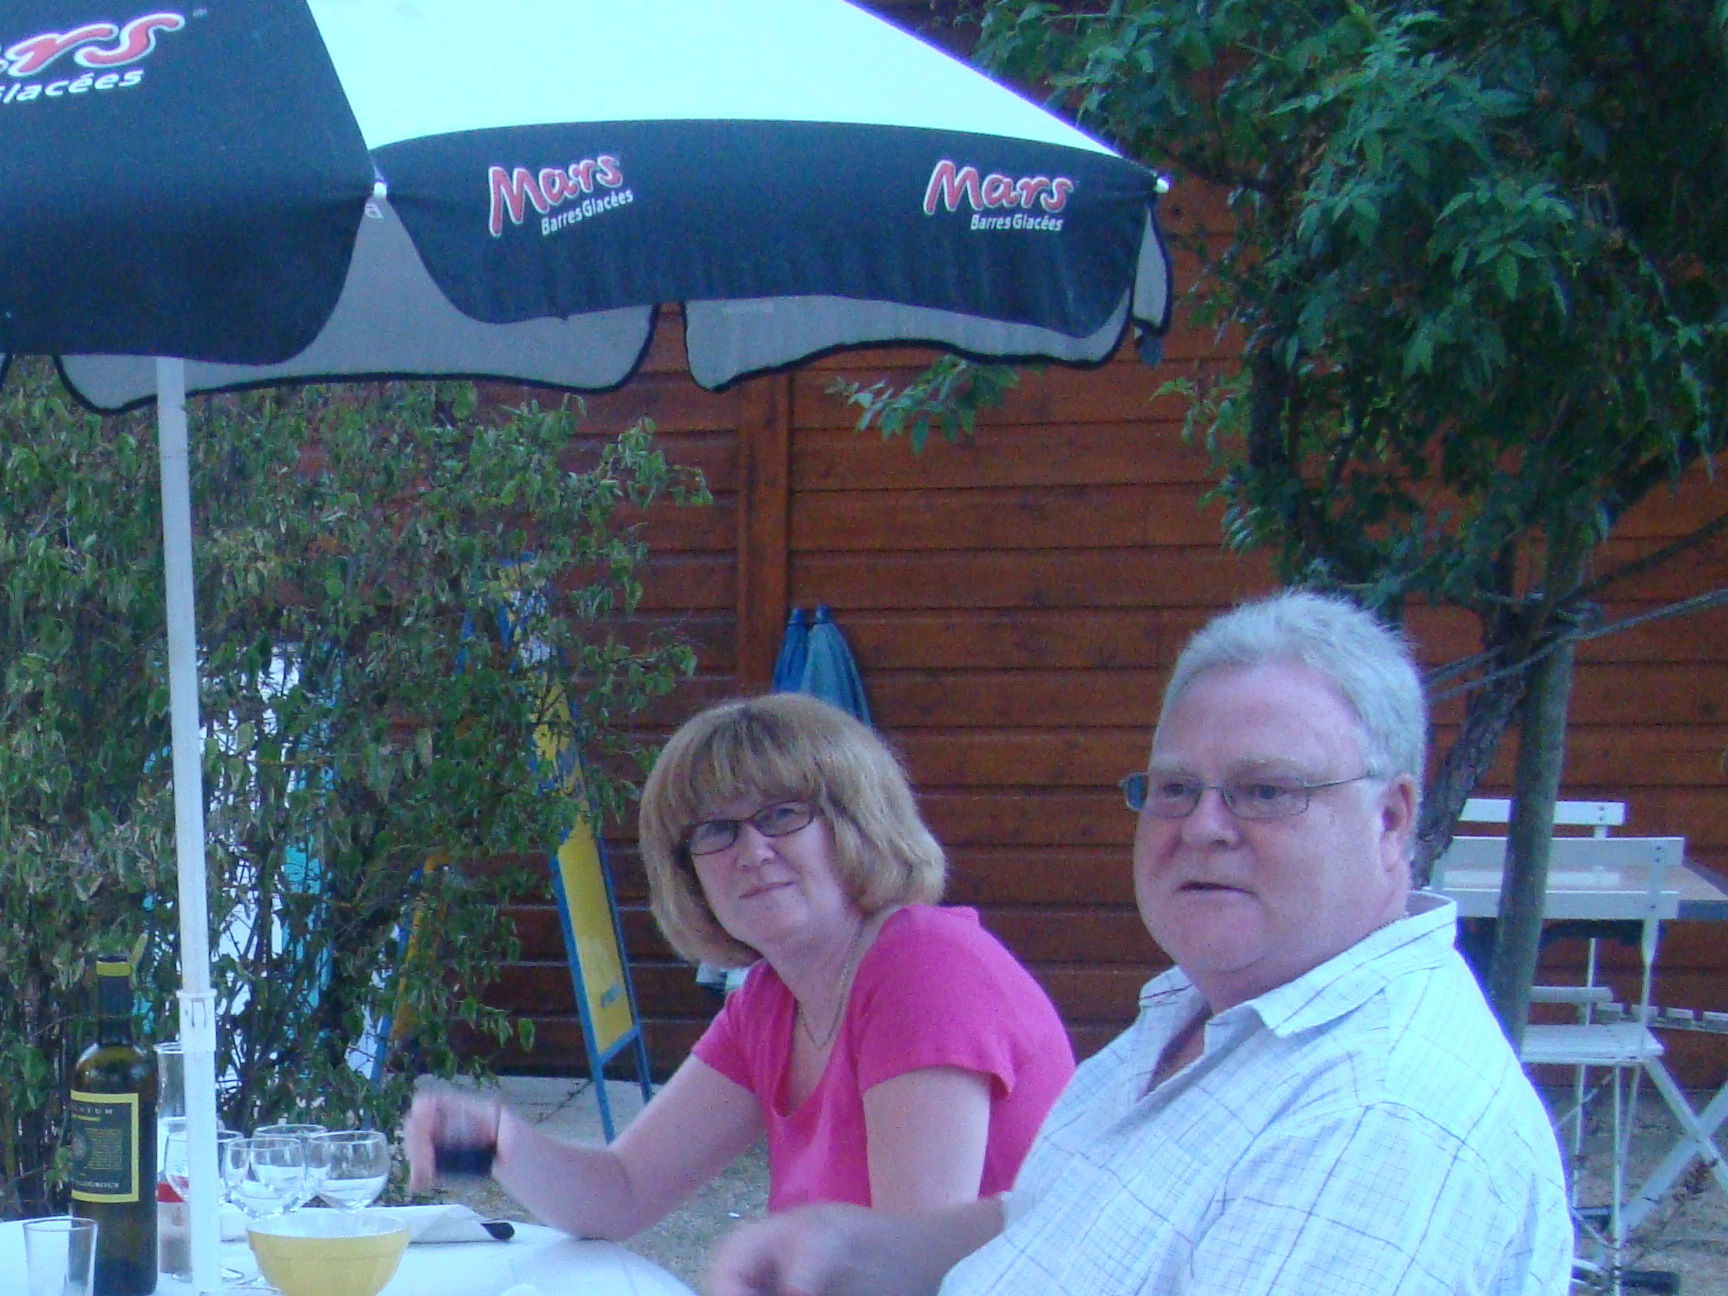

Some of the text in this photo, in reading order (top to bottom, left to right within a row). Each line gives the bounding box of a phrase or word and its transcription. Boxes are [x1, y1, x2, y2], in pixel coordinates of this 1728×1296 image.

[488, 155, 623, 239] Mars
[923, 159, 1074, 216] Mars
[541, 208, 583, 236] Barres
[970, 214, 1012, 230] Barres
